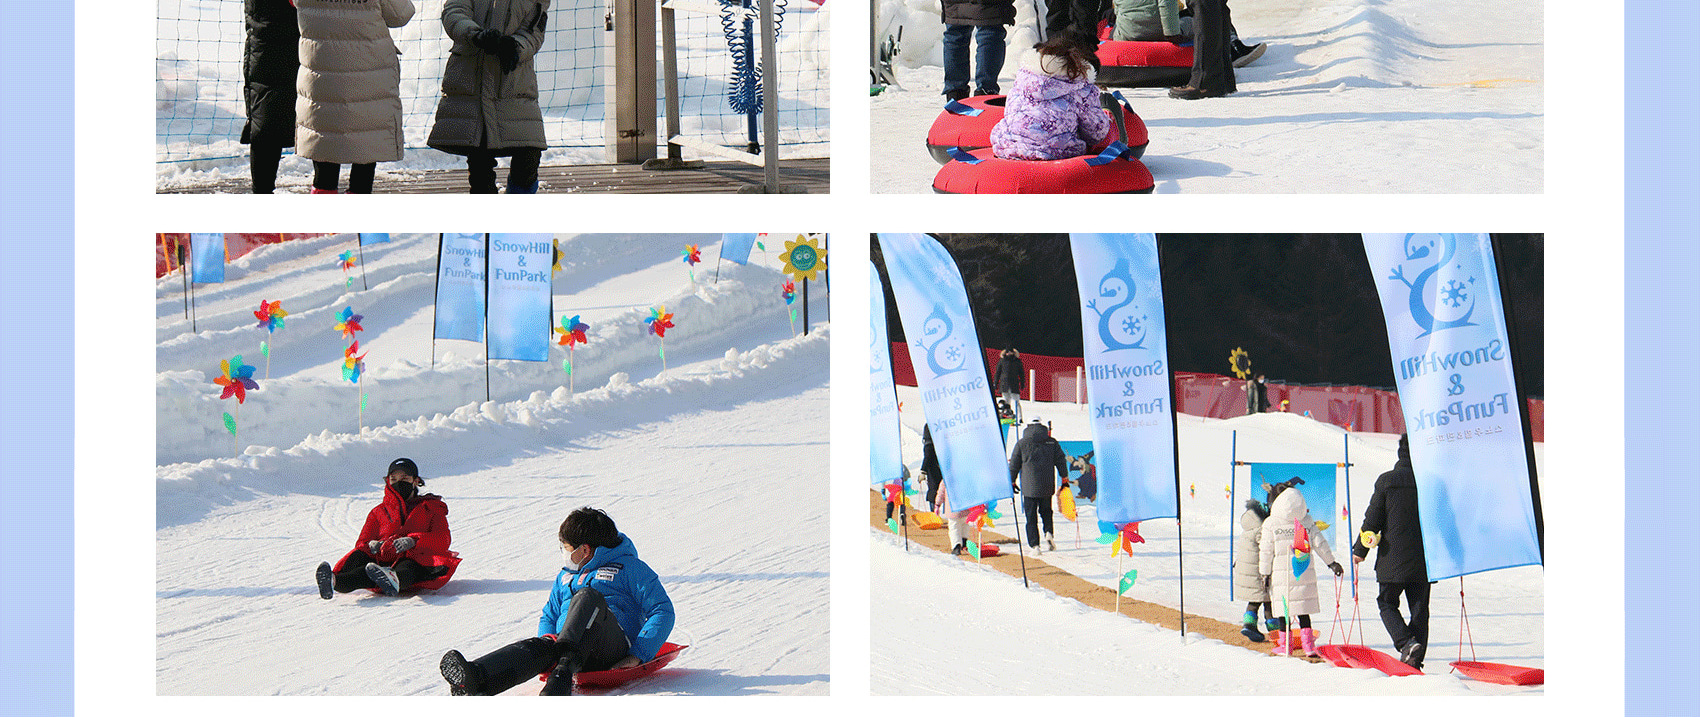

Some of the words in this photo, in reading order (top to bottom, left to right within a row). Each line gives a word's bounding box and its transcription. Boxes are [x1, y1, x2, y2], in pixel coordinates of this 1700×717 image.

[444, 245, 485, 259] SnowHi
[494, 240, 550, 254] SnowHill
[463, 257, 472, 267] &
[518, 255, 527, 267] &
[445, 267, 485, 281] FunPark
[495, 268, 547, 283] FunPark
